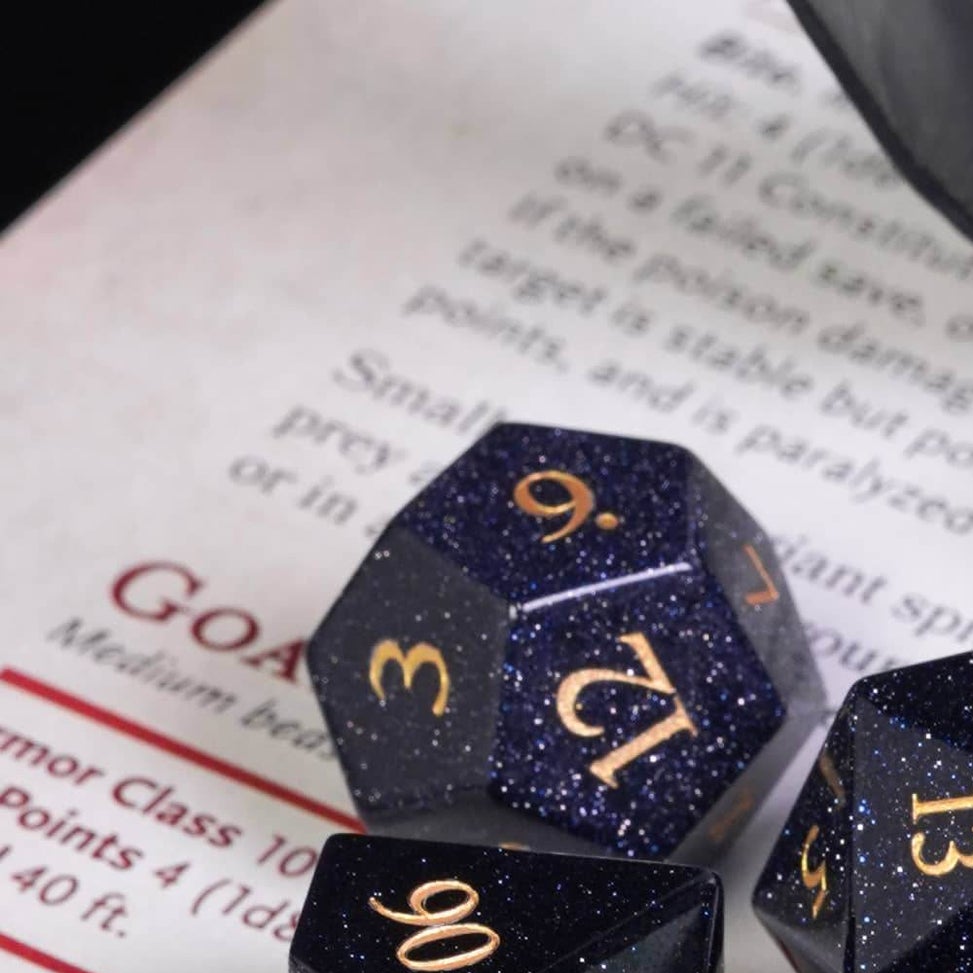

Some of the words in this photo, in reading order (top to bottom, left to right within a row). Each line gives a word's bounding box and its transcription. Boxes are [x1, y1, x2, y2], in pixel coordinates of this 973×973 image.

[585, 357, 698, 415] and
[661, 324, 817, 400] stable
[820, 378, 908, 438] but
[298, 475, 357, 525] in
[47, 615, 237, 716] Medium
[368, 638, 451, 718] 3
[555, 632, 699, 791] 12
[111, 775, 243, 849] Class
[256, 832, 318, 879] 10
[11, 864, 79, 906] 40
[80, 891, 127, 940] ft.
[154, 861, 190, 890] 4
[367, 878, 501, 973] 90
